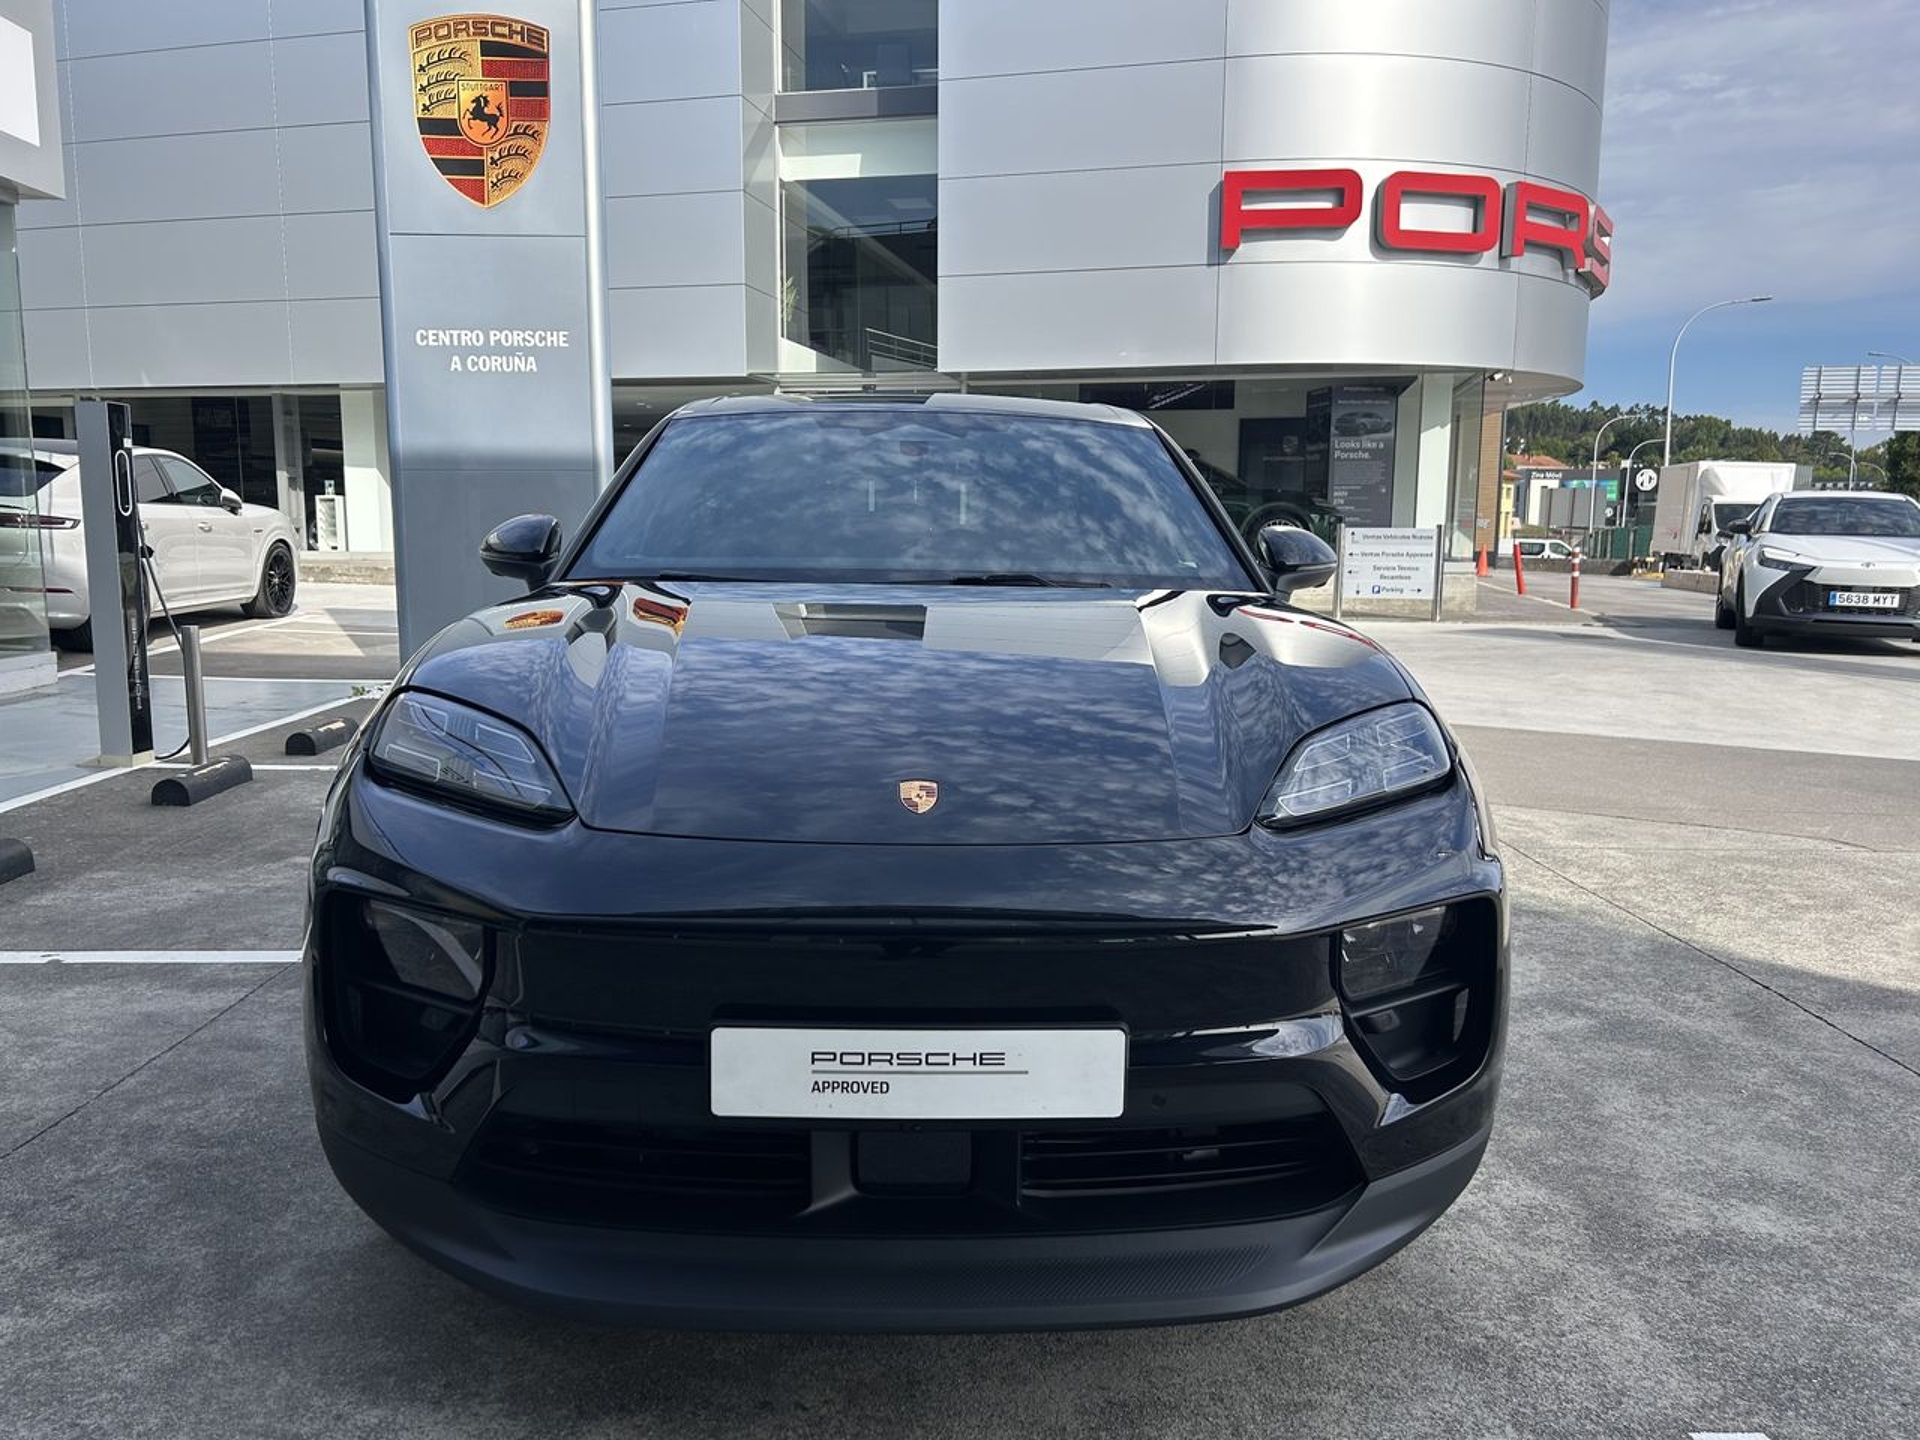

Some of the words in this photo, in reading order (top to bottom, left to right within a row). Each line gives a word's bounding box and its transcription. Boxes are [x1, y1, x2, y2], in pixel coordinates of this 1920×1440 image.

[414, 20, 546, 48] PORSCHE
[461, 82, 504, 92] STUTTGART
[415, 329, 485, 347] CENTRO
[489, 330, 570, 348] PORSCHE
[450, 356, 462, 372] A
[466, 351, 538, 373] CORUÑA
[1334, 439, 1360, 449] Looks
[1362, 438, 1378, 449] like
[1381, 586, 1404, 594] Parking
[1838, 593, 1870, 605] 5638
[811, 1052, 1006, 1067] PORSCHE
[811, 1080, 890, 1096] APPROVED
